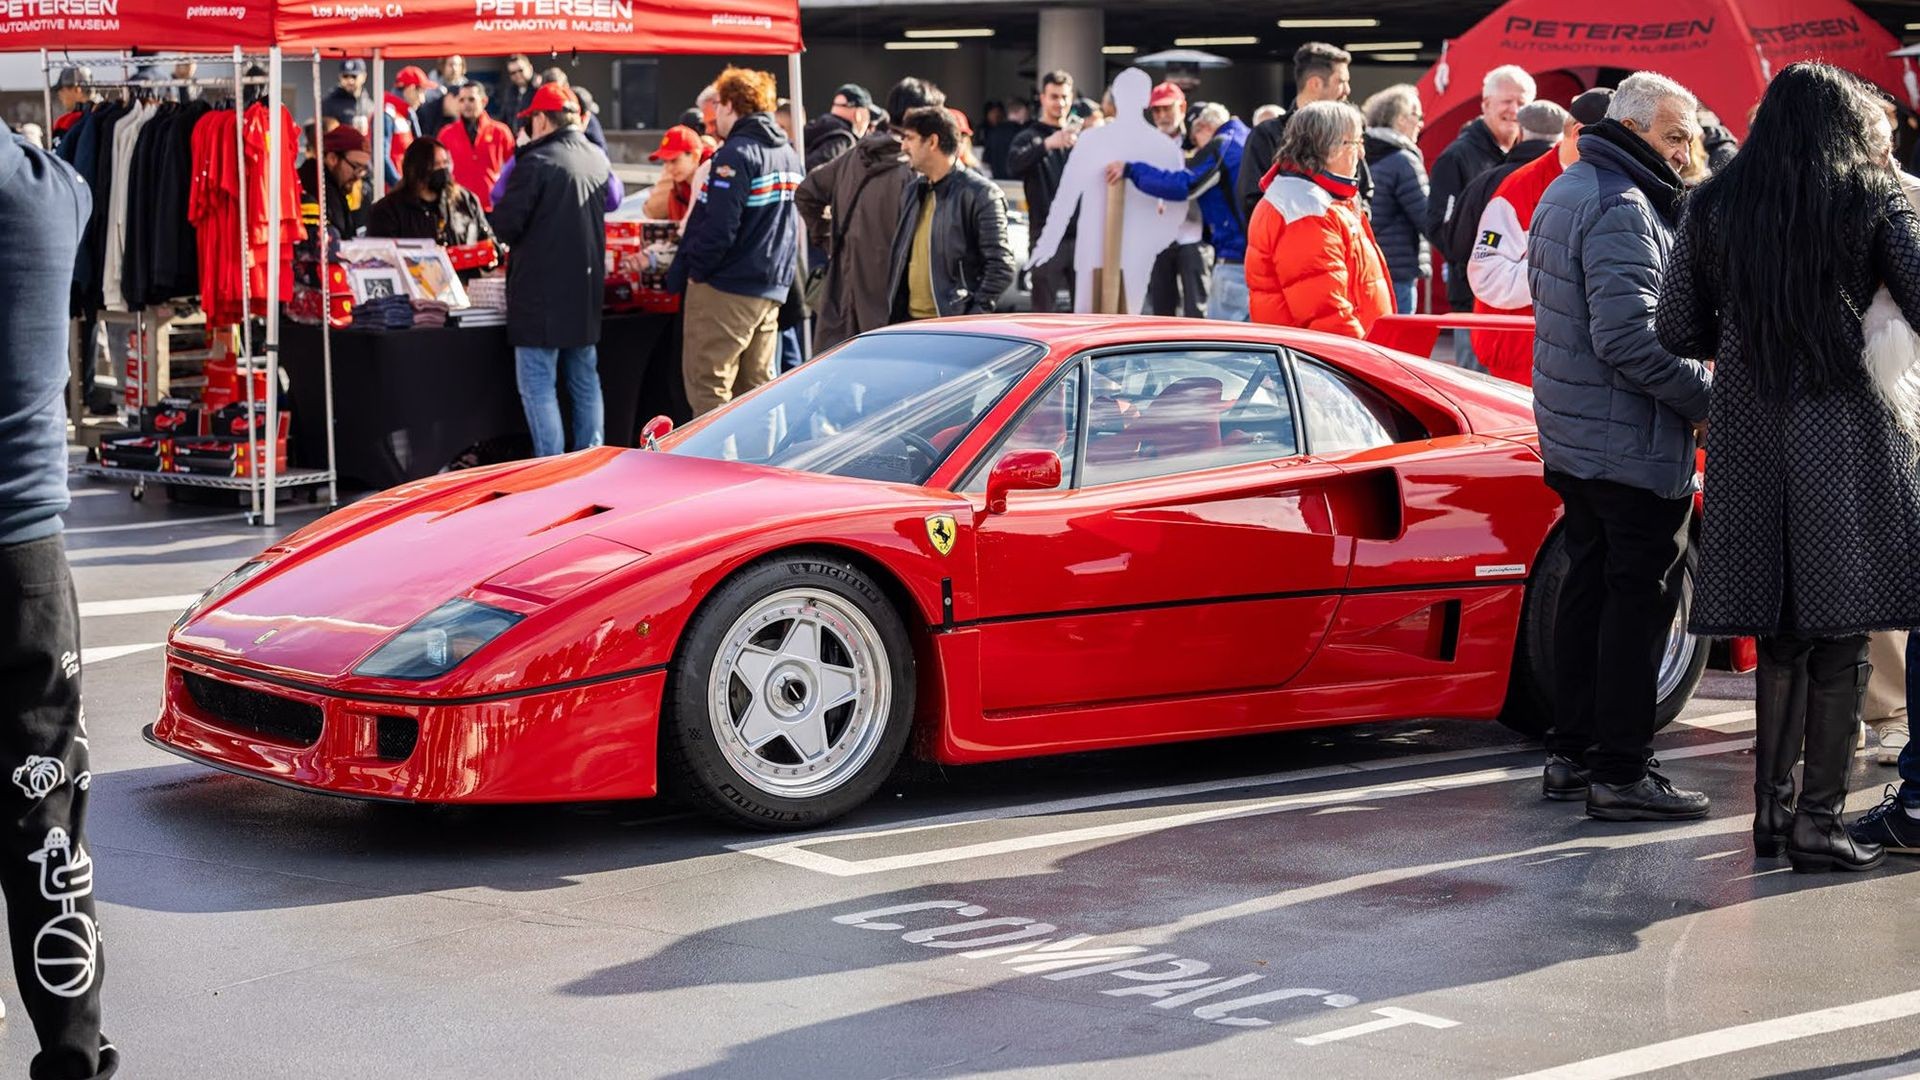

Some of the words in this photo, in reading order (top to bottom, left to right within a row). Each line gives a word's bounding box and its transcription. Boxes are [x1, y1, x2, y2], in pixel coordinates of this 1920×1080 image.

[186, 6, 246, 19] petersen.org
[311, 5, 333, 17] Los
[335, 4, 383, 20] Angeles,
[386, 3, 403, 17] CA
[475, 0, 633, 18] PETERSEN
[68, 19, 119, 31] MUSEUM
[474, 19, 567, 31] AUTOMOTIVE
[572, 20, 633, 33] MUSEUM
[711, 13, 771, 29] petersen.org
[1505, 16, 1714, 40] PETERSEN
[1750, 16, 1859, 42] ETERSEN
[808, 563, 879, 603] MICHELIN
[831, 899, 1463, 1047] COMPACT
